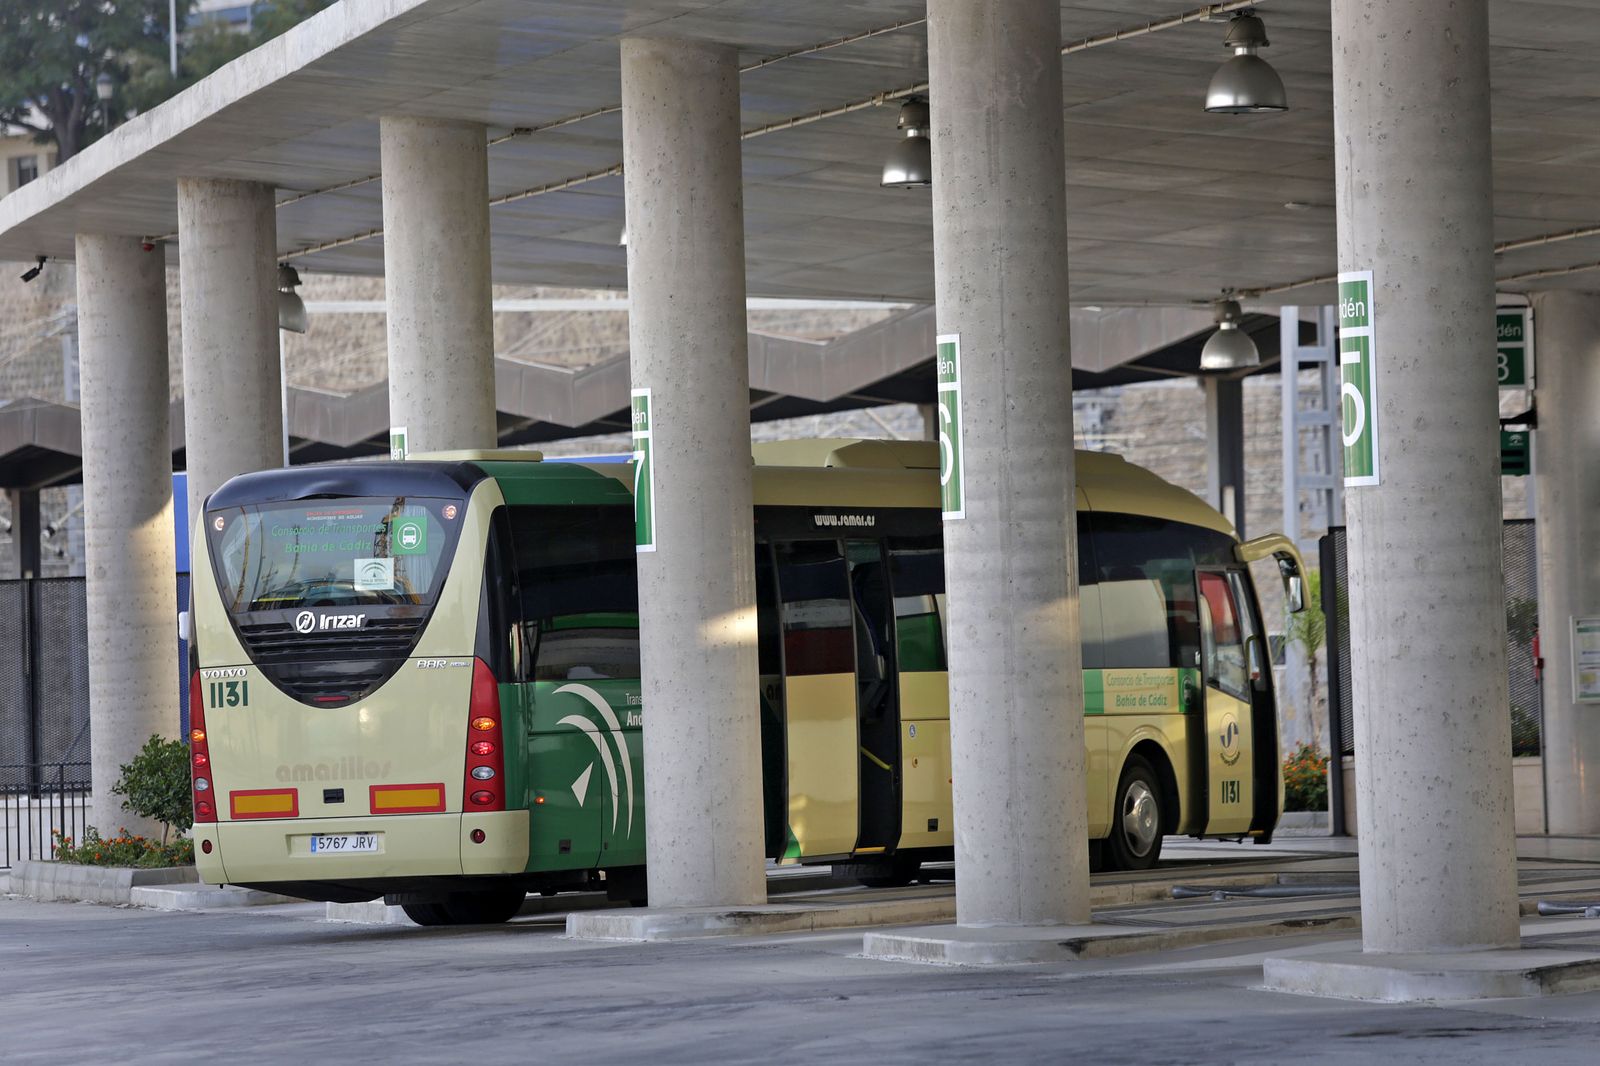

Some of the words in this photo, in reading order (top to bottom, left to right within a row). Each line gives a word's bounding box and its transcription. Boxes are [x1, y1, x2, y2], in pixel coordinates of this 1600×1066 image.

[1339, 297, 1365, 318] dén
[1497, 324, 1521, 336] dén
[319, 522, 330, 535] de
[322, 541, 336, 552] de
[319, 614, 366, 630] Irizar
[202, 668, 248, 680] VOLVO
[210, 680, 248, 709] 1131
[625, 692, 643, 705] Trans
[275, 756, 391, 782] amarillos
[1221, 781, 1240, 804] 1131
[318, 837, 347, 849] 5767
[352, 836, 374, 849] JRV
